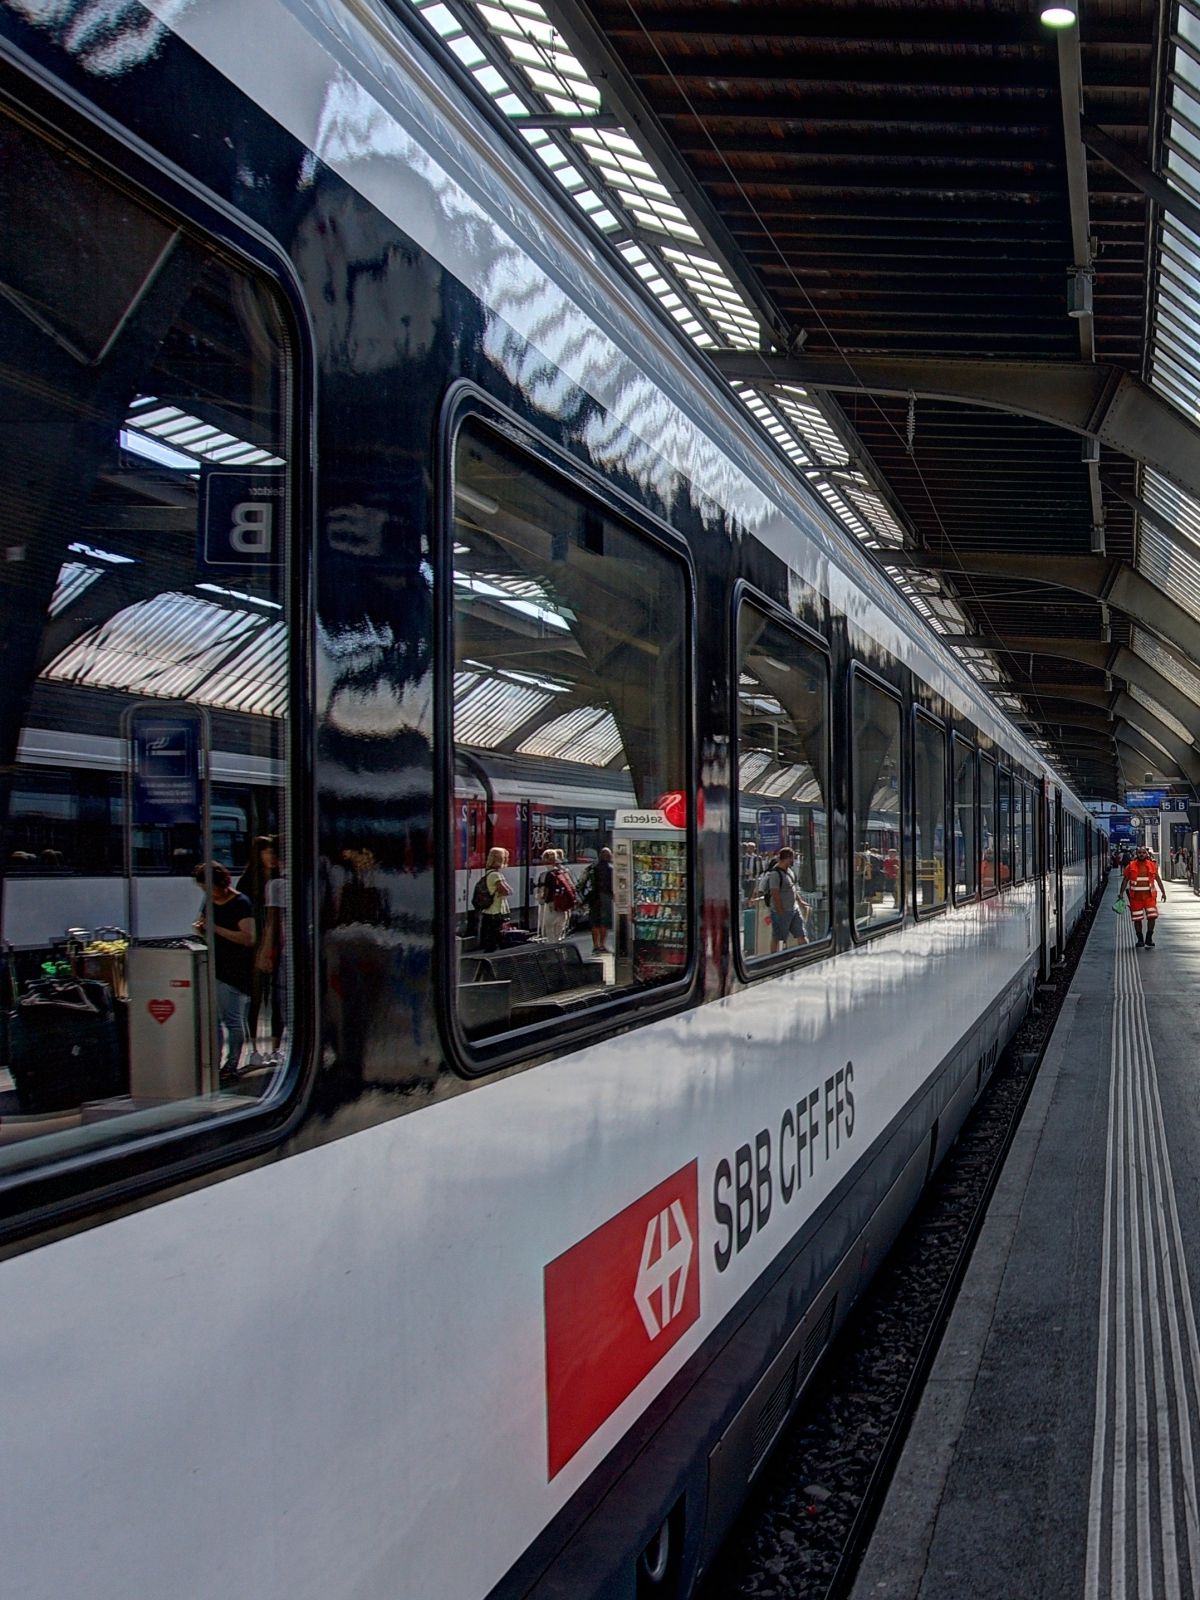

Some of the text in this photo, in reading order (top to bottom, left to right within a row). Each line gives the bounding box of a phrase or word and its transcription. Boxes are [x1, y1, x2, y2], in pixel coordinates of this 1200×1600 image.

[1162, 802, 1170, 810] 15
[1178, 802, 1185, 810] B
[714, 1060, 855, 1273] SBB CFF FFS
